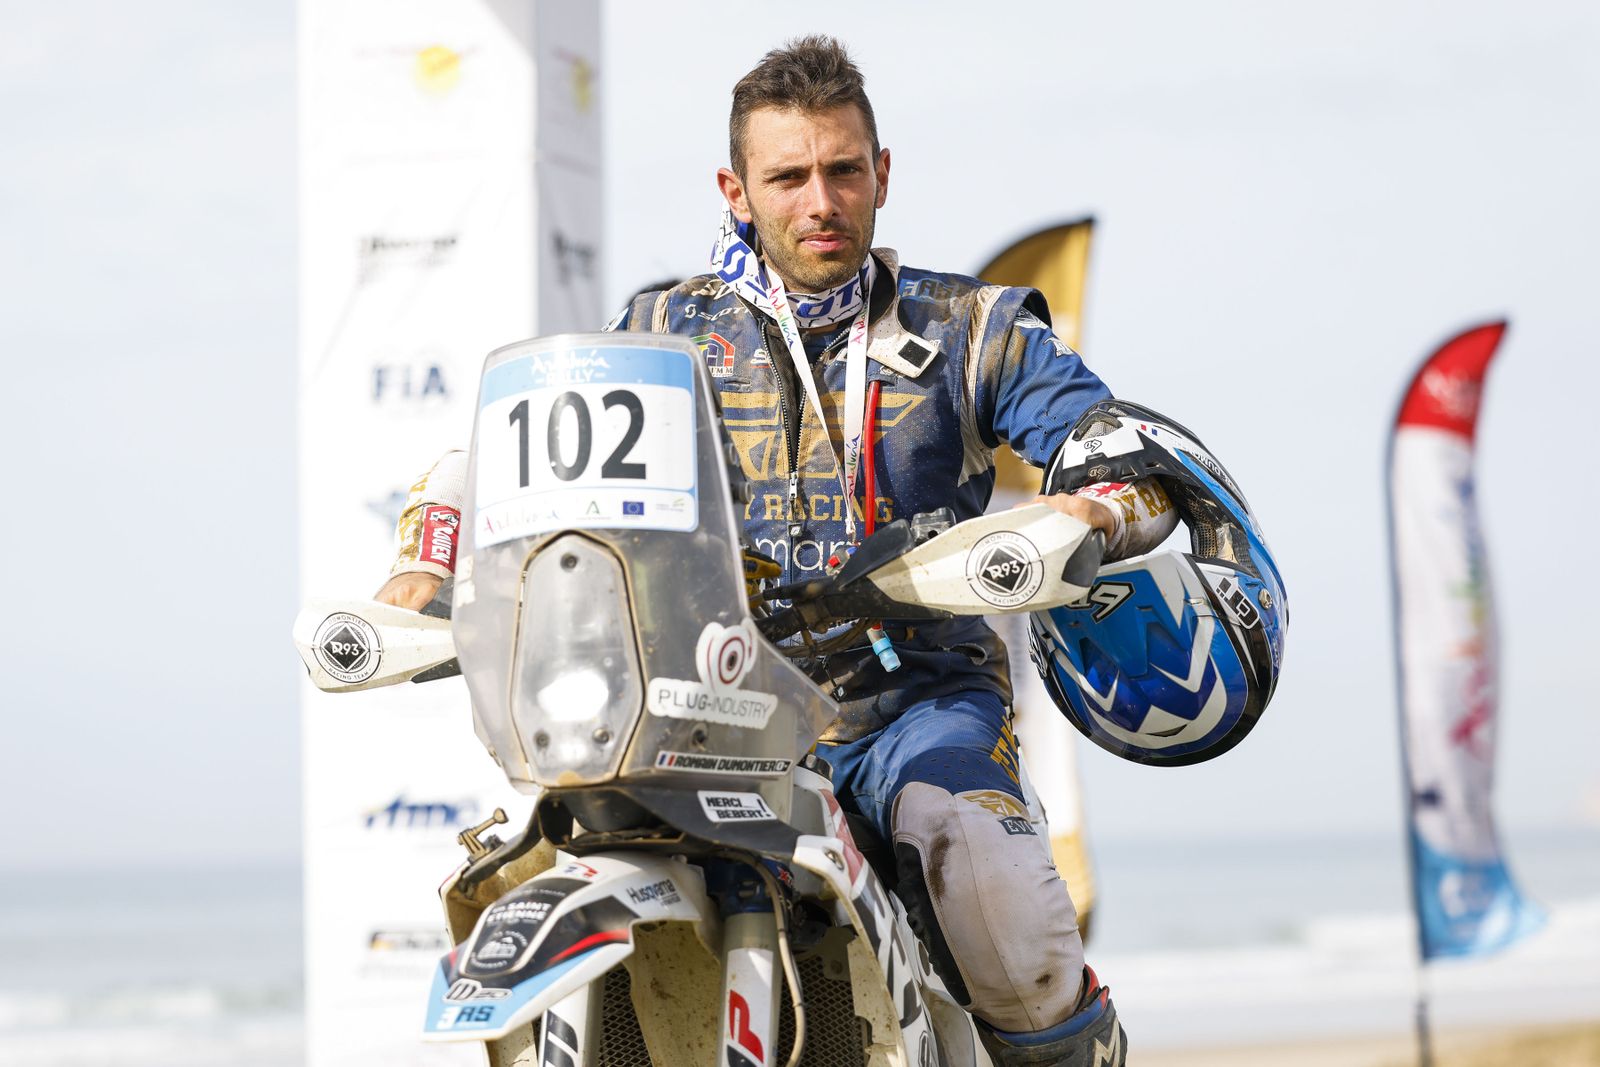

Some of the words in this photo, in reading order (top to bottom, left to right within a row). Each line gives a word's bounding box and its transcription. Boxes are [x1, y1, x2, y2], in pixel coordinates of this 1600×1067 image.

[531, 349, 611, 377] Anlucía
[545, 368, 595, 386] RLLY
[371, 363, 449, 402] FIA
[509, 389, 647, 488] 102
[658, 688, 772, 719] PLUG-INDUSTRY
[674, 755, 717, 770] ROMAIN
[717, 758, 777, 772] DUMONTIER
[705, 796, 743, 808] MERCI
